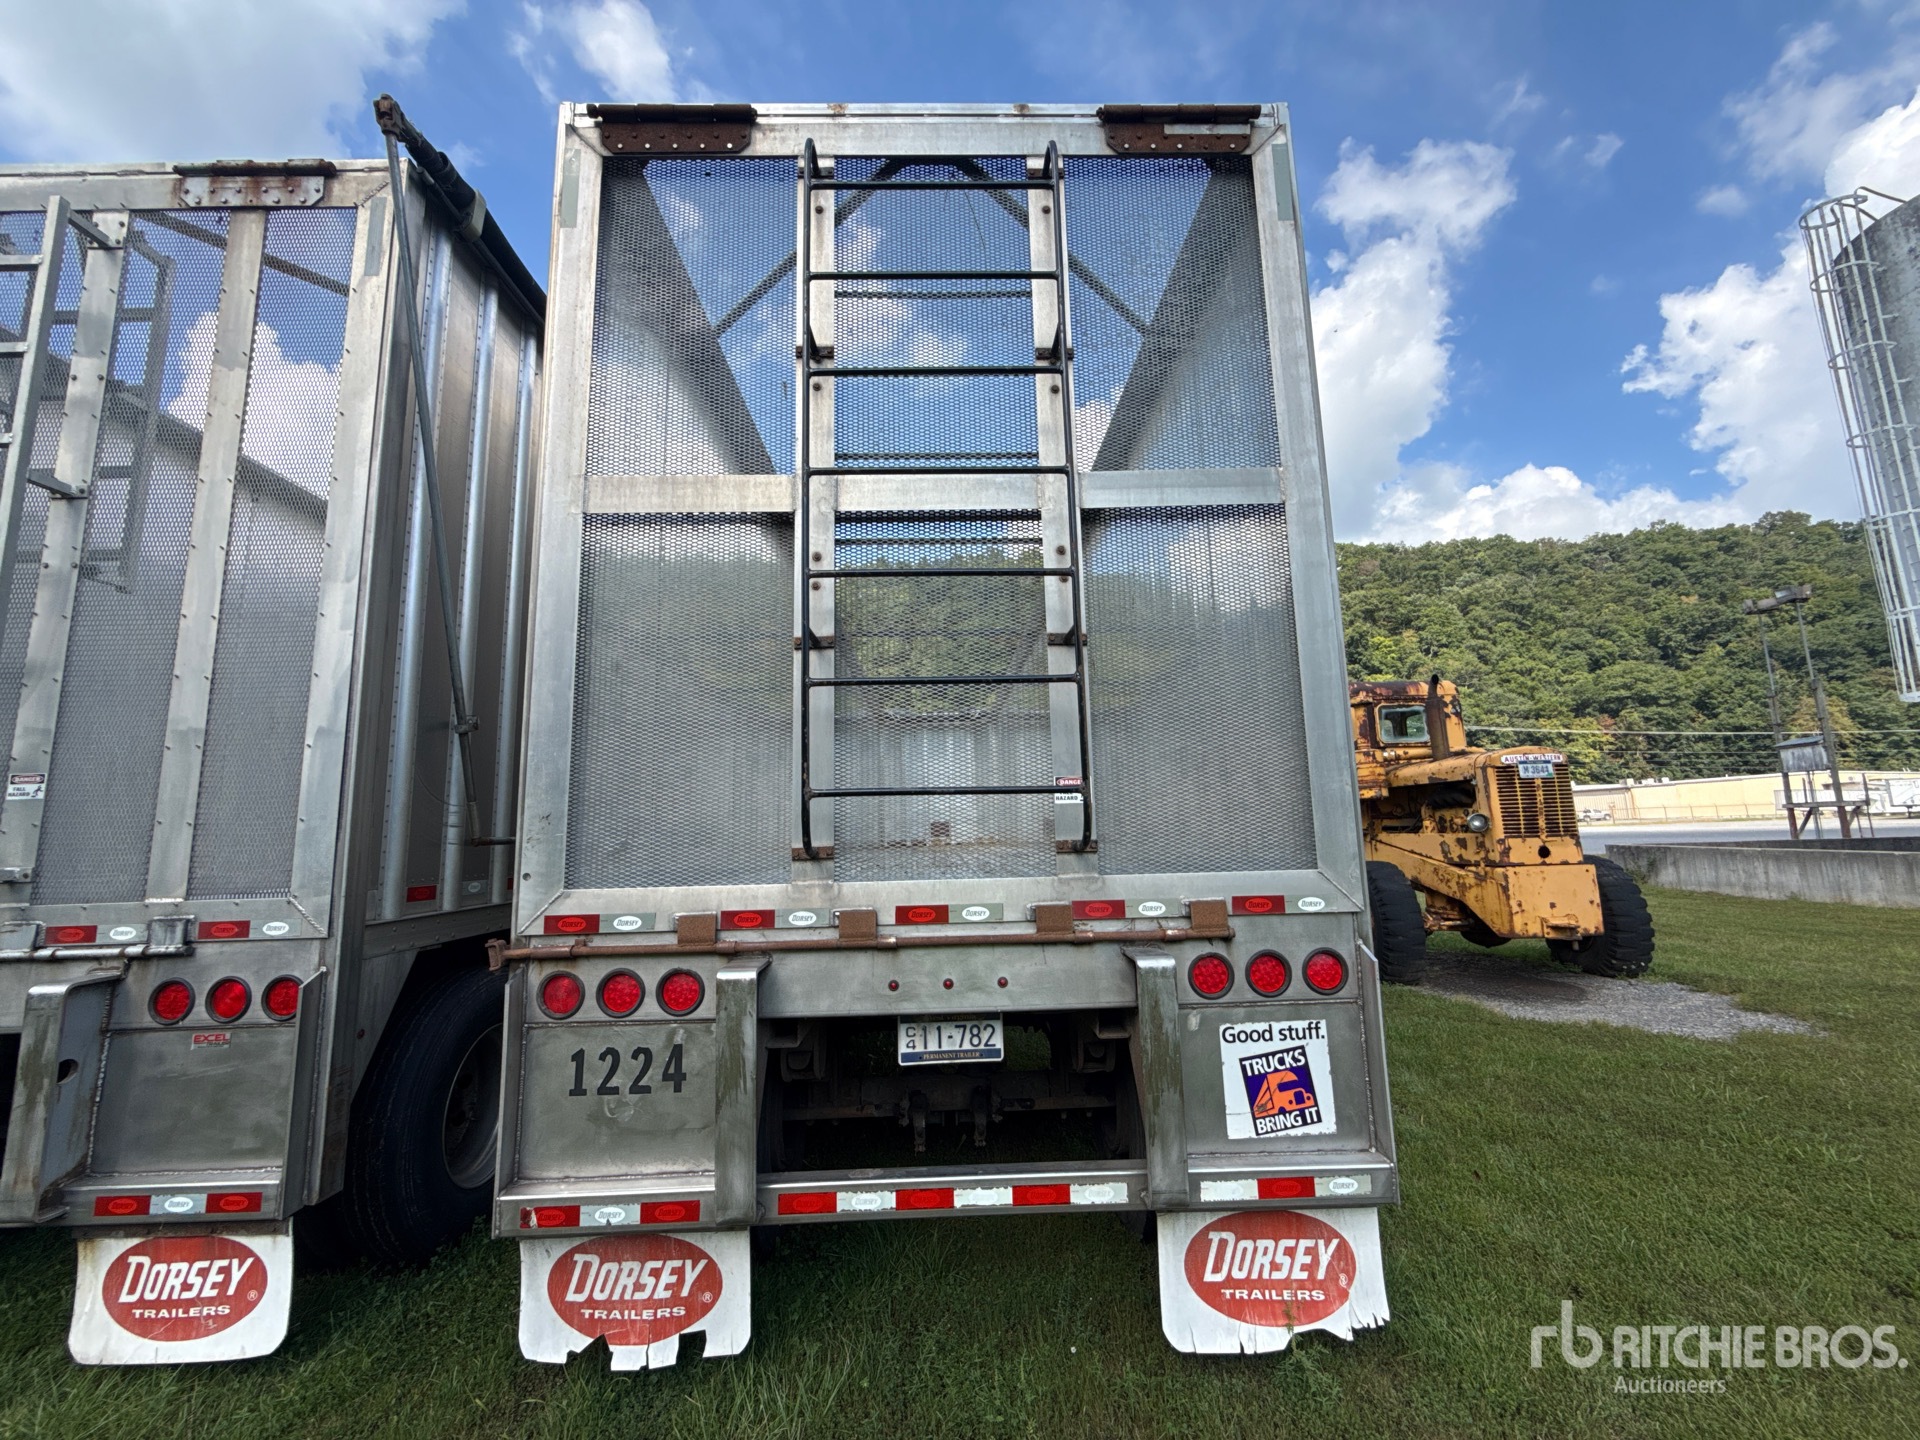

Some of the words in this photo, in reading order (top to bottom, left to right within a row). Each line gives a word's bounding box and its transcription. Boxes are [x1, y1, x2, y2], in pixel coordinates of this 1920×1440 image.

[1141, 904, 1164, 913] DORSEY
[1247, 900, 1270, 909] DORSEY
[1300, 899, 1323, 908] DORSEY
[965, 909, 988, 918] DORSEY
[1088, 905, 1111, 914] DORSEY
[737, 915, 760, 924] DORSEY
[791, 914, 814, 923] DORSEY
[911, 911, 933, 919] DORSEY
[561, 920, 584, 929] DORSEY
[616, 918, 639, 927] DORSEY
[921, 1023, 996, 1050] 11-782
[1222, 1024, 1274, 1043] Good
[1278, 1021, 1325, 1041] stuff.
[194, 1033, 231, 1042] EXCEL
[1242, 1049, 1305, 1076] TRUCKS
[569, 1043, 687, 1096] 1224
[1255, 1110, 1303, 1134] BRING
[1304, 1107, 1319, 1124] IT
[1332, 1181, 1355, 1190] DORSEY
[538, 1211, 563, 1221] DORSEY
[598, 1209, 622, 1219] DORSEY
[658, 1207, 682, 1217] DORSEY
[1203, 1231, 1340, 1282] DORSEY
[118, 1255, 255, 1303] DORSEY
[565, 1253, 708, 1302] DORSEY
[1221, 1289, 1325, 1301] TRAILERS
[132, 1305, 231, 1319] TRAILERS
[581, 1307, 686, 1320] TRAILERS
